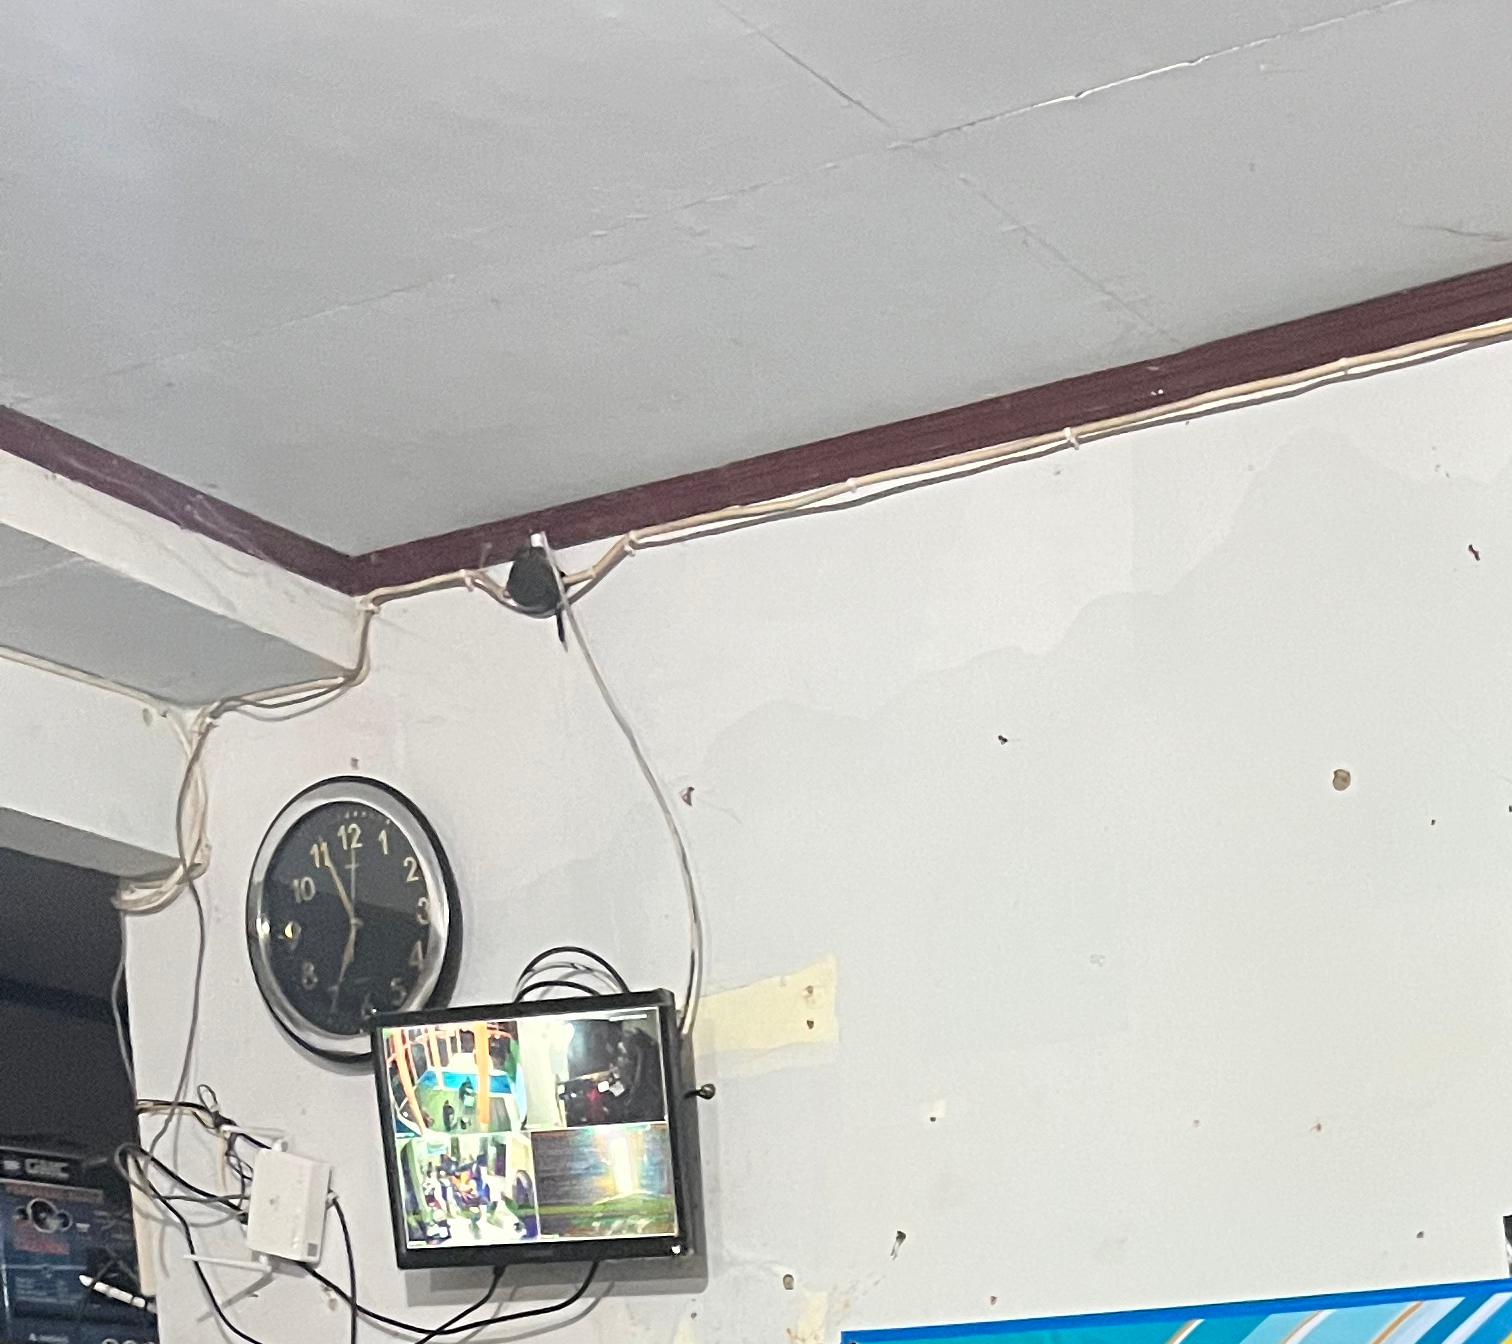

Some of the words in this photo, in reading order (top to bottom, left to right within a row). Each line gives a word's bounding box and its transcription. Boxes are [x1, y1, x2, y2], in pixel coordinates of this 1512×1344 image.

[337, 823, 363, 850] 12
[378, 829, 388, 855] 1
[310, 842, 333, 868] 11
[403, 857, 419, 882] 2
[291, 876, 316, 904] 10
